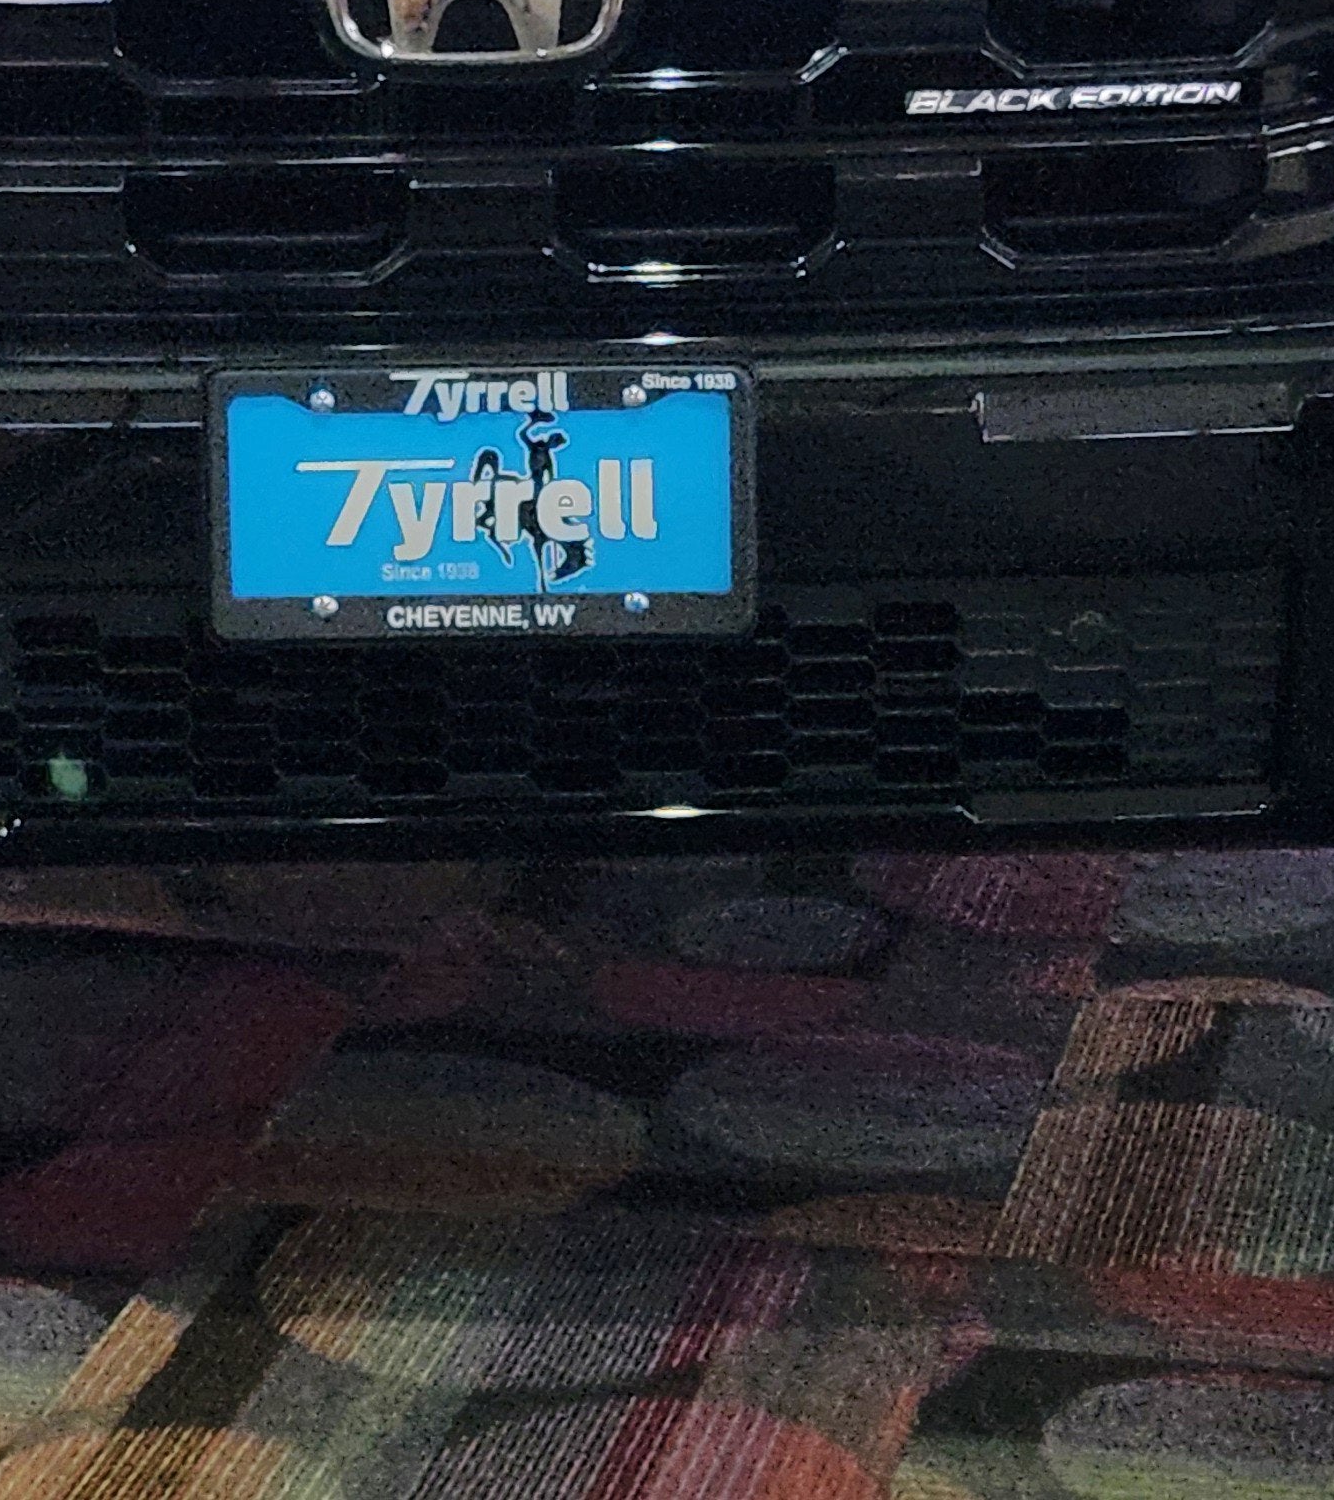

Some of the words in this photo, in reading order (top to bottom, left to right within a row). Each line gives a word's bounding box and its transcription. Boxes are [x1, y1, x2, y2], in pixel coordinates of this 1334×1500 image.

[906, 88, 1065, 115] BLACK
[1067, 80, 1242, 109] EDITION
[389, 371, 570, 422] Tyrrell
[641, 372, 692, 390] Since
[694, 372, 737, 390] 1938
[295, 458, 658, 562] Tyrrell
[381, 563, 433, 582] Since
[386, 604, 530, 630] CHEYENNE,
[533, 603, 577, 627] WY
